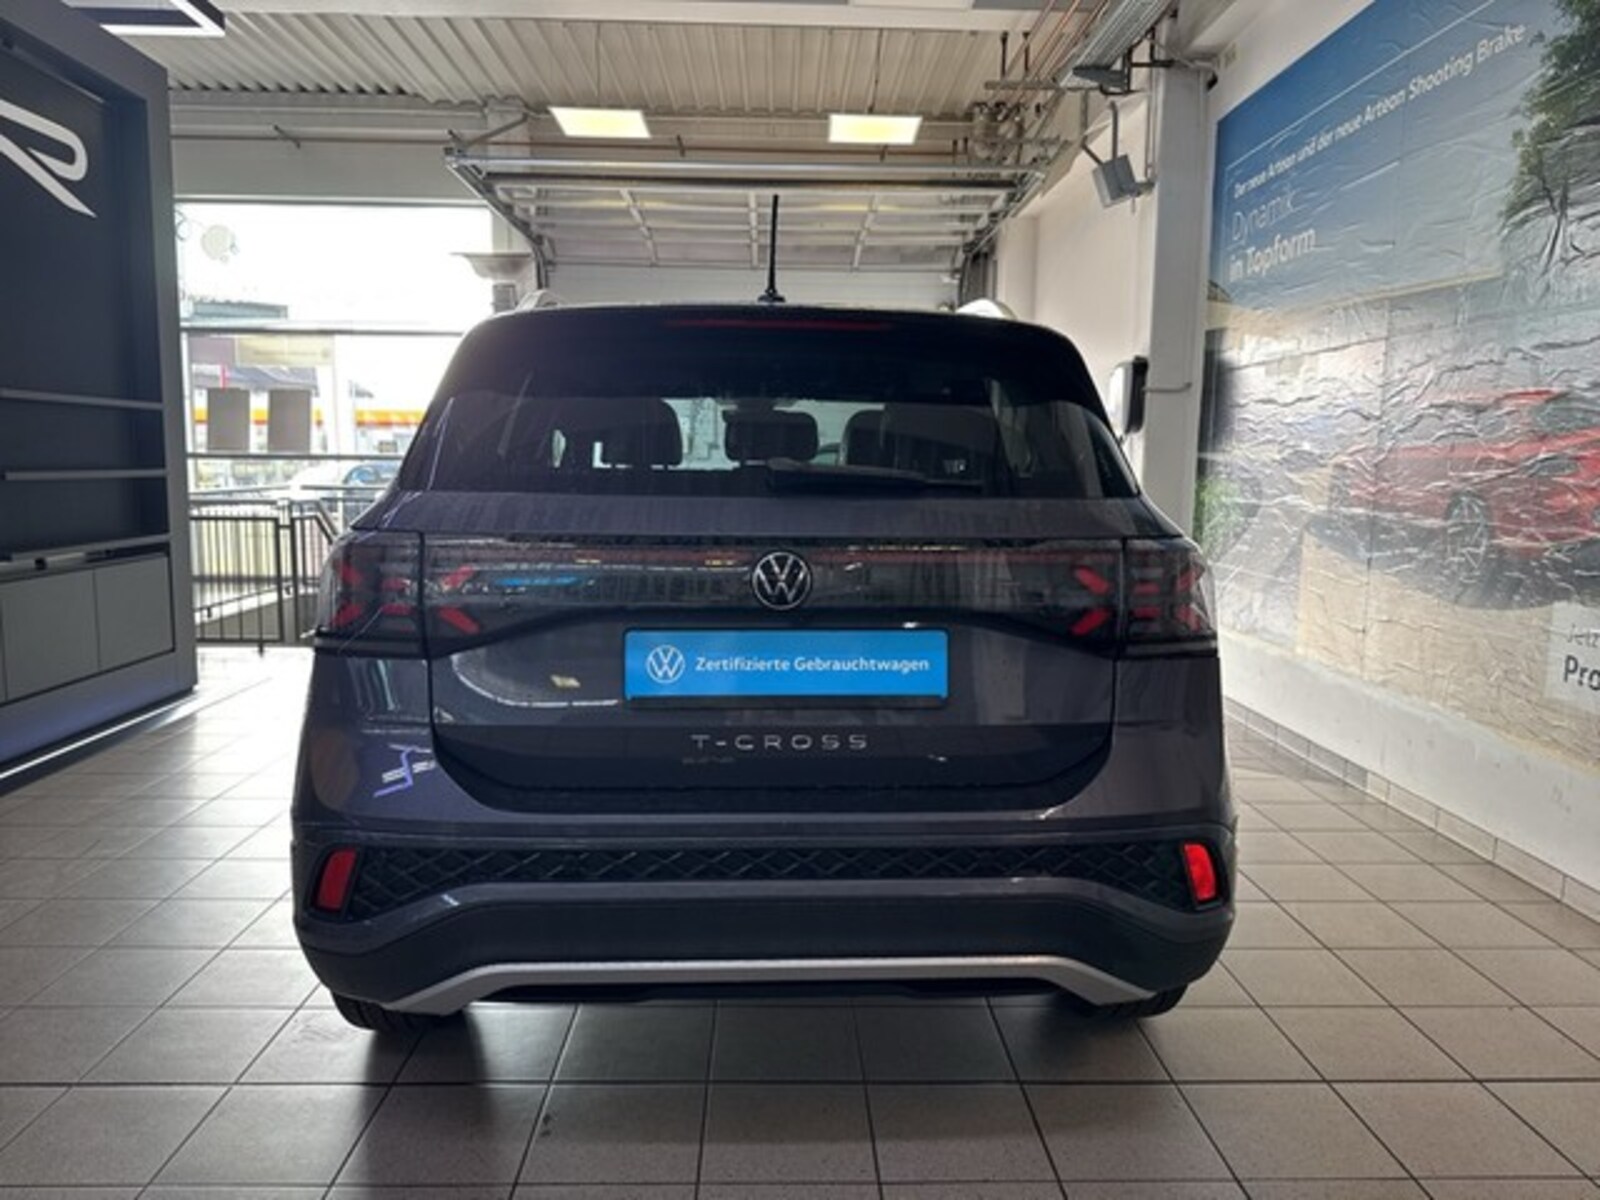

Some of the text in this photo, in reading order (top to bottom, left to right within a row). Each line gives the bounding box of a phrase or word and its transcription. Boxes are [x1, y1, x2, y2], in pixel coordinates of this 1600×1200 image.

[1363, 90, 1406, 124] Arteon
[1408, 52, 1474, 100] Shooting
[1477, 24, 1526, 64] Brake
[1231, 182, 1297, 248] Dynamik
[1229, 228, 1316, 282] in Topform
[695, 656, 789, 671] Zertifizierte
[794, 656, 929, 675] Gebrauchtwagen
[690, 734, 867, 750] T-CROSS
